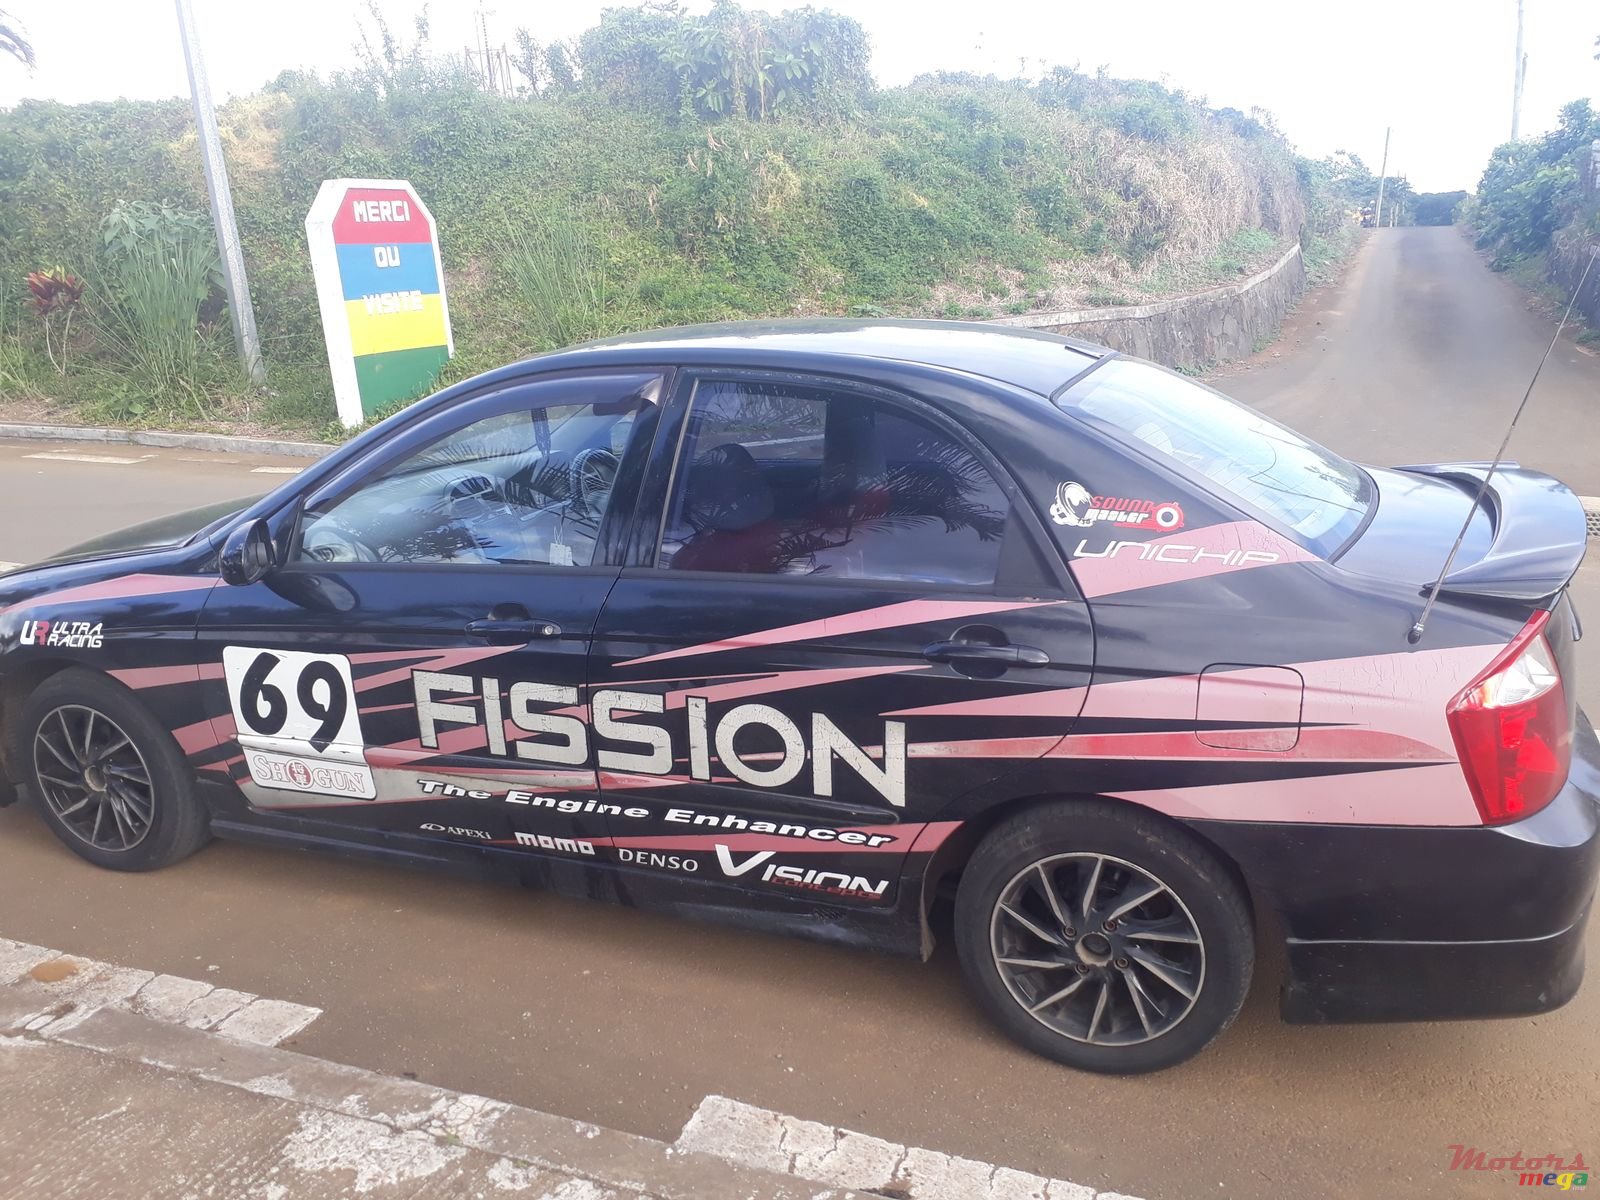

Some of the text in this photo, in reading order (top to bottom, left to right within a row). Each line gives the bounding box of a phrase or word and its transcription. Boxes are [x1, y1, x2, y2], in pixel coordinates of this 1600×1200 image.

[353, 200, 411, 223] MERCI
[373, 246, 401, 268] OU
[362, 290, 424, 315] VISITE
[1091, 495, 1156, 513] SOUND
[1073, 539, 1280, 567] UNICHIP
[52, 621, 103, 635] ULTRA
[47, 633, 104, 648] RACING
[240, 652, 347, 753] 69
[411, 670, 907, 807] FISSION
[253, 754, 365, 793] SHOGUN
[417, 779, 893, 847] The Engine Enhancer
[618, 848, 698, 872] DENSO
